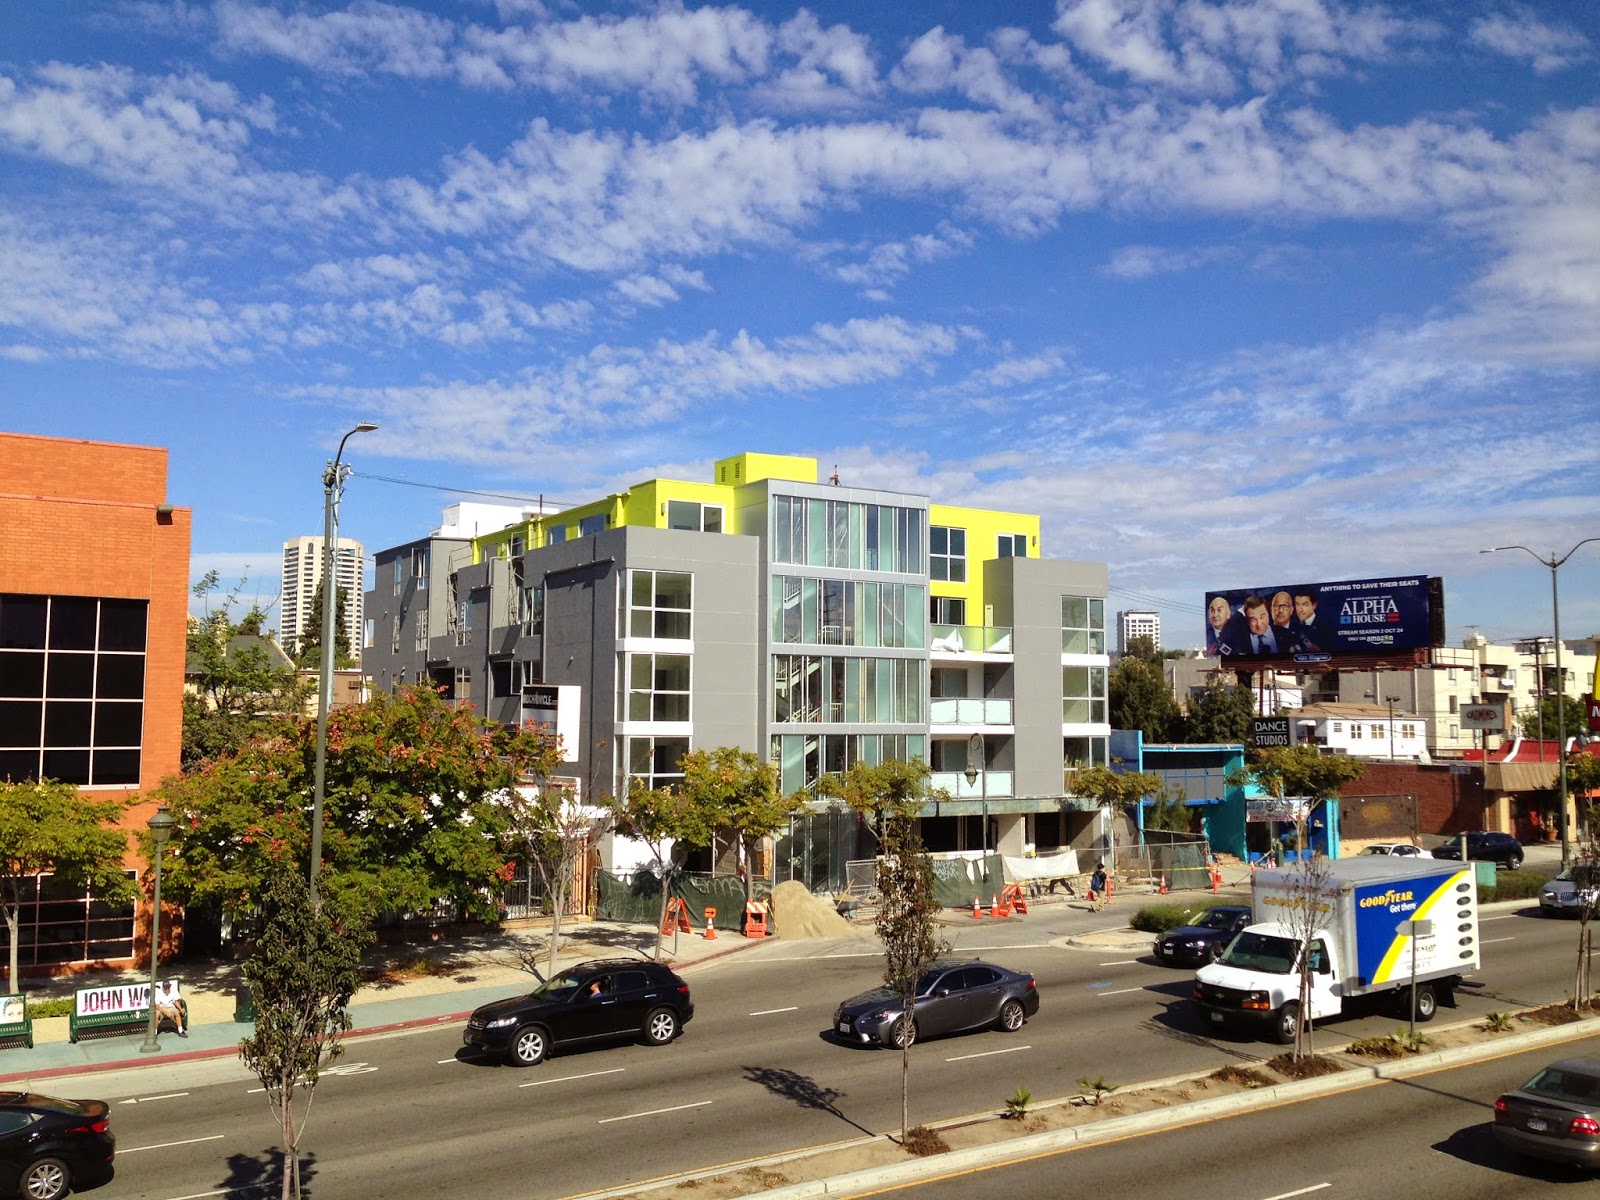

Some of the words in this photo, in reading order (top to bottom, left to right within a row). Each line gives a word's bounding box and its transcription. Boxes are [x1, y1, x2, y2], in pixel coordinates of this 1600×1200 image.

[1398, 579, 1420, 587] SEATS
[1341, 599, 1399, 615] ALPHA
[1352, 613, 1386, 624] HOUSE
[1255, 721, 1287, 731] DANCE
[1256, 735, 1287, 745] STUDIOS
[1359, 889, 1414, 908] GOODYEAR
[1389, 904, 1401, 914] Get
[1401, 902, 1417, 912] there
[82, 989, 123, 1013] JOHN
